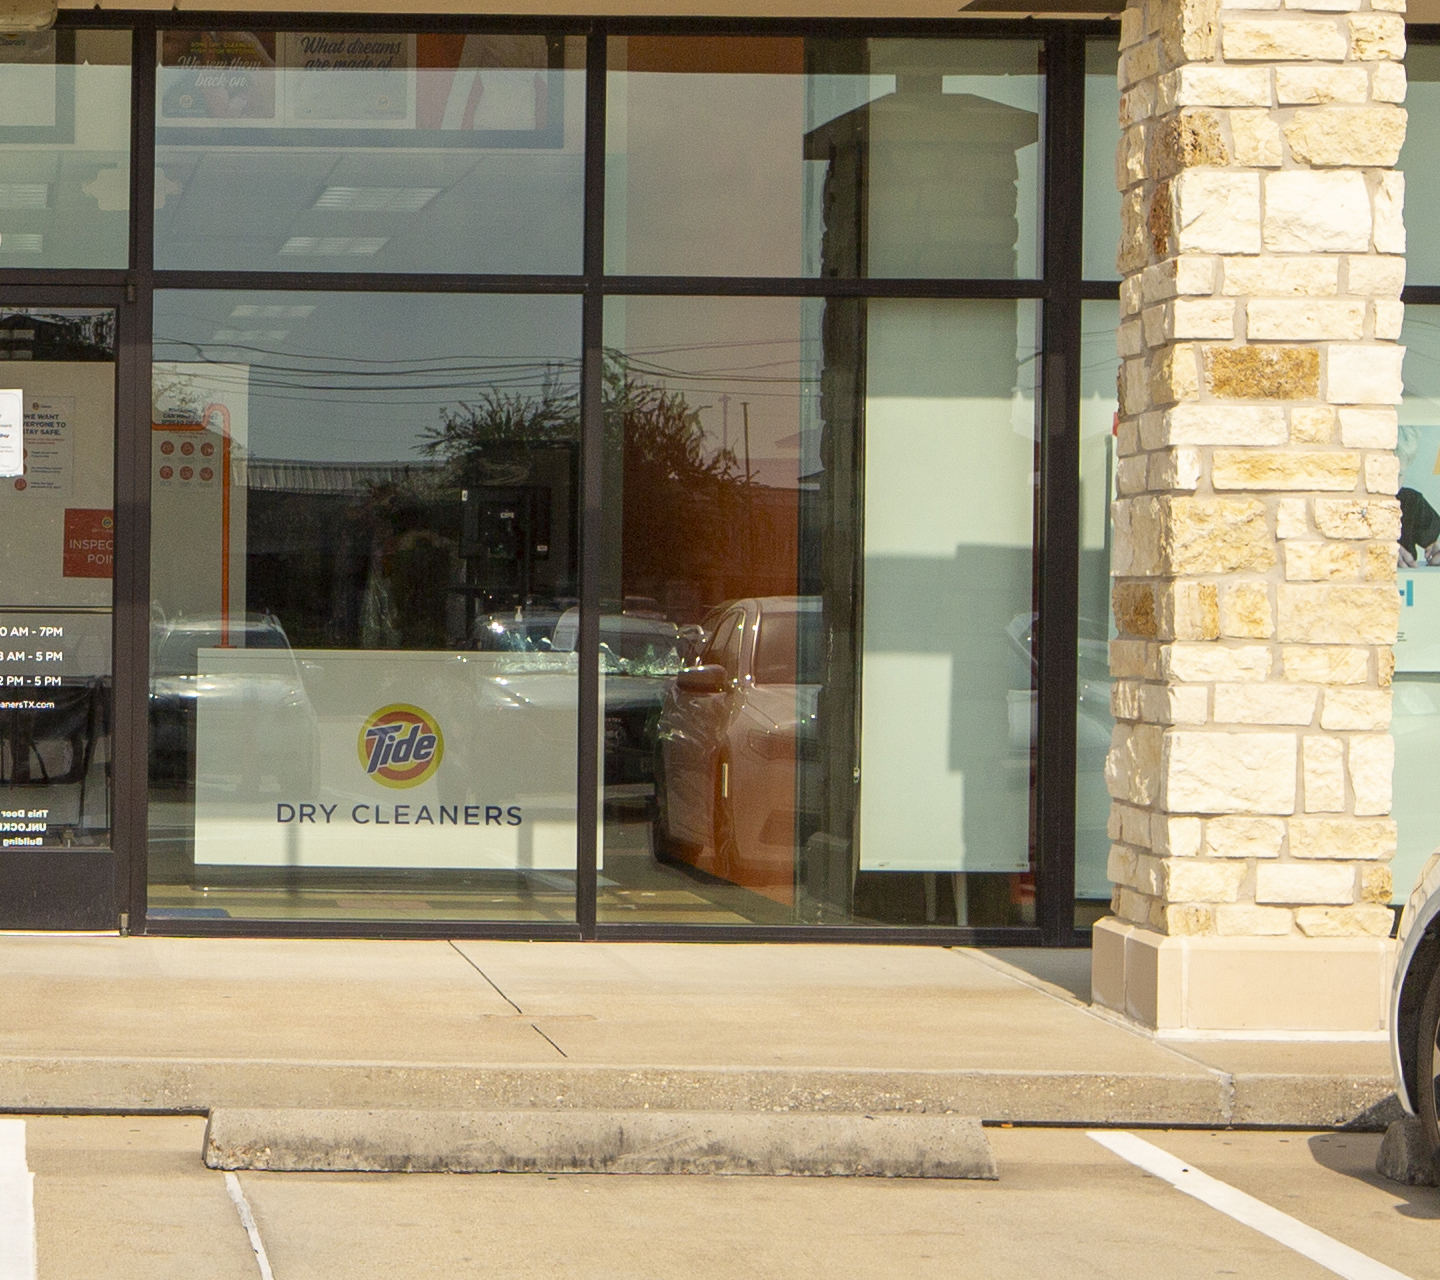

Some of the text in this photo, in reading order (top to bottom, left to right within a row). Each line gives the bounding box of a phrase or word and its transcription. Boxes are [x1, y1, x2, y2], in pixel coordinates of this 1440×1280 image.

[300, 36, 401, 55] What dreams
[332, 55, 374, 71] made
[194, 72, 227, 87] back
[69, 539, 113, 550] INSPEC
[10, 627, 29, 637] AM
[39, 627, 63, 637] 7PM
[6, 651, 25, 662] AM
[35, 651, 43, 662] 5
[45, 651, 63, 662] PM
[6, 676, 24, 686] PM
[34, 676, 42, 686] 5
[44, 676, 62, 686] PM
[365, 722, 437, 774] Tide
[276, 803, 523, 826] DRY CLEANERS
